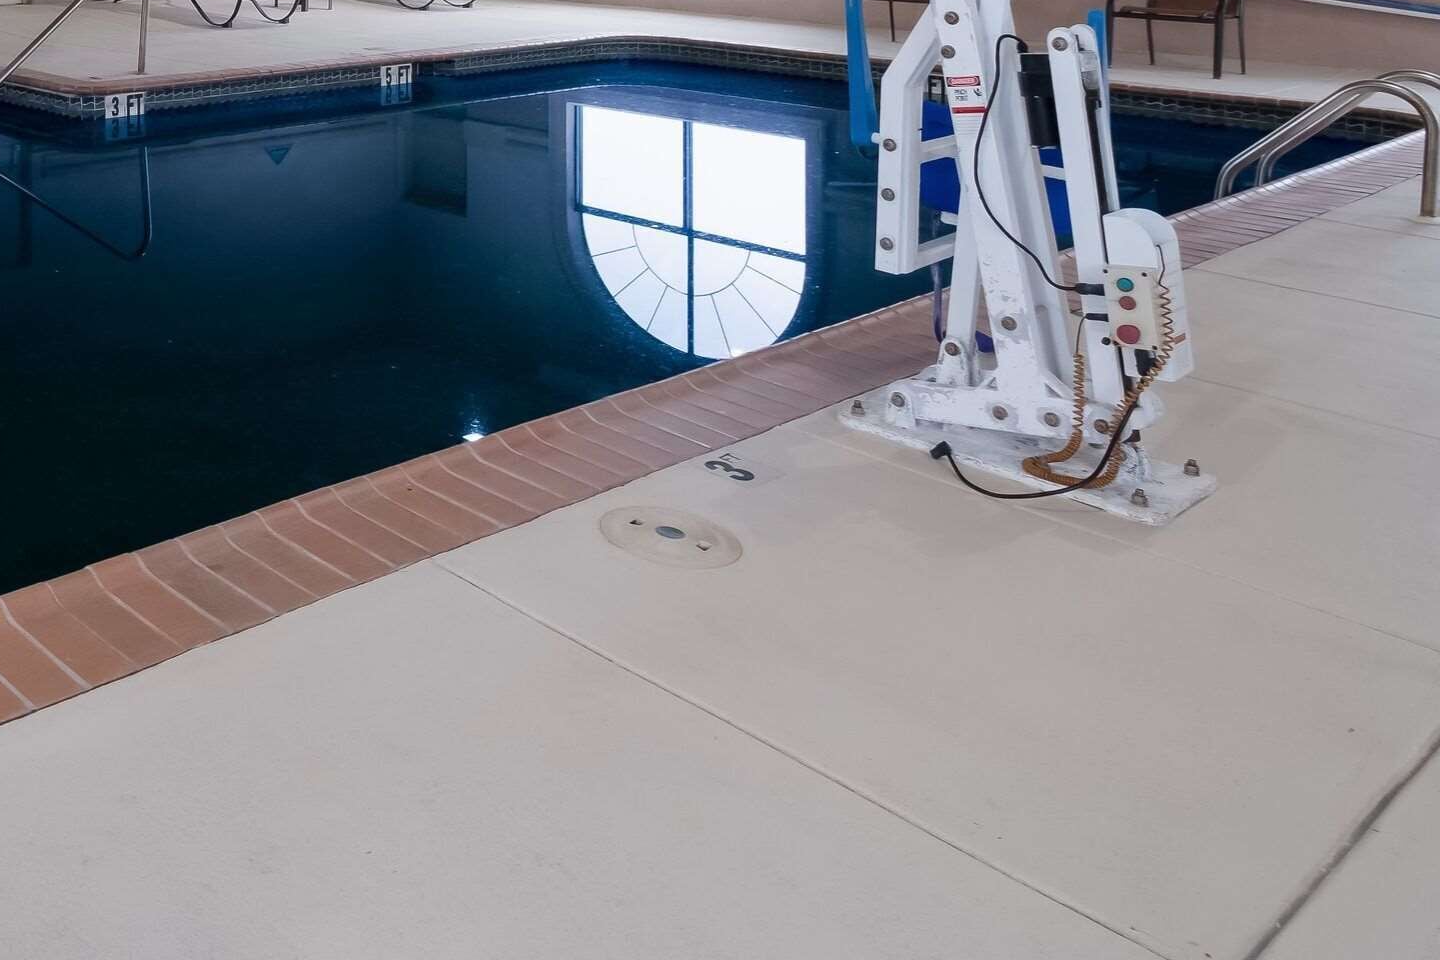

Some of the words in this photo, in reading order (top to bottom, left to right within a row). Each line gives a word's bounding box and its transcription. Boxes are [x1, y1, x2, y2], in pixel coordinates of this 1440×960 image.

[386, 66, 392, 85] 5
[398, 64, 411, 85] FT
[111, 96, 120, 117] 3
[127, 93, 143, 117] FT
[704, 460, 755, 481] 3
